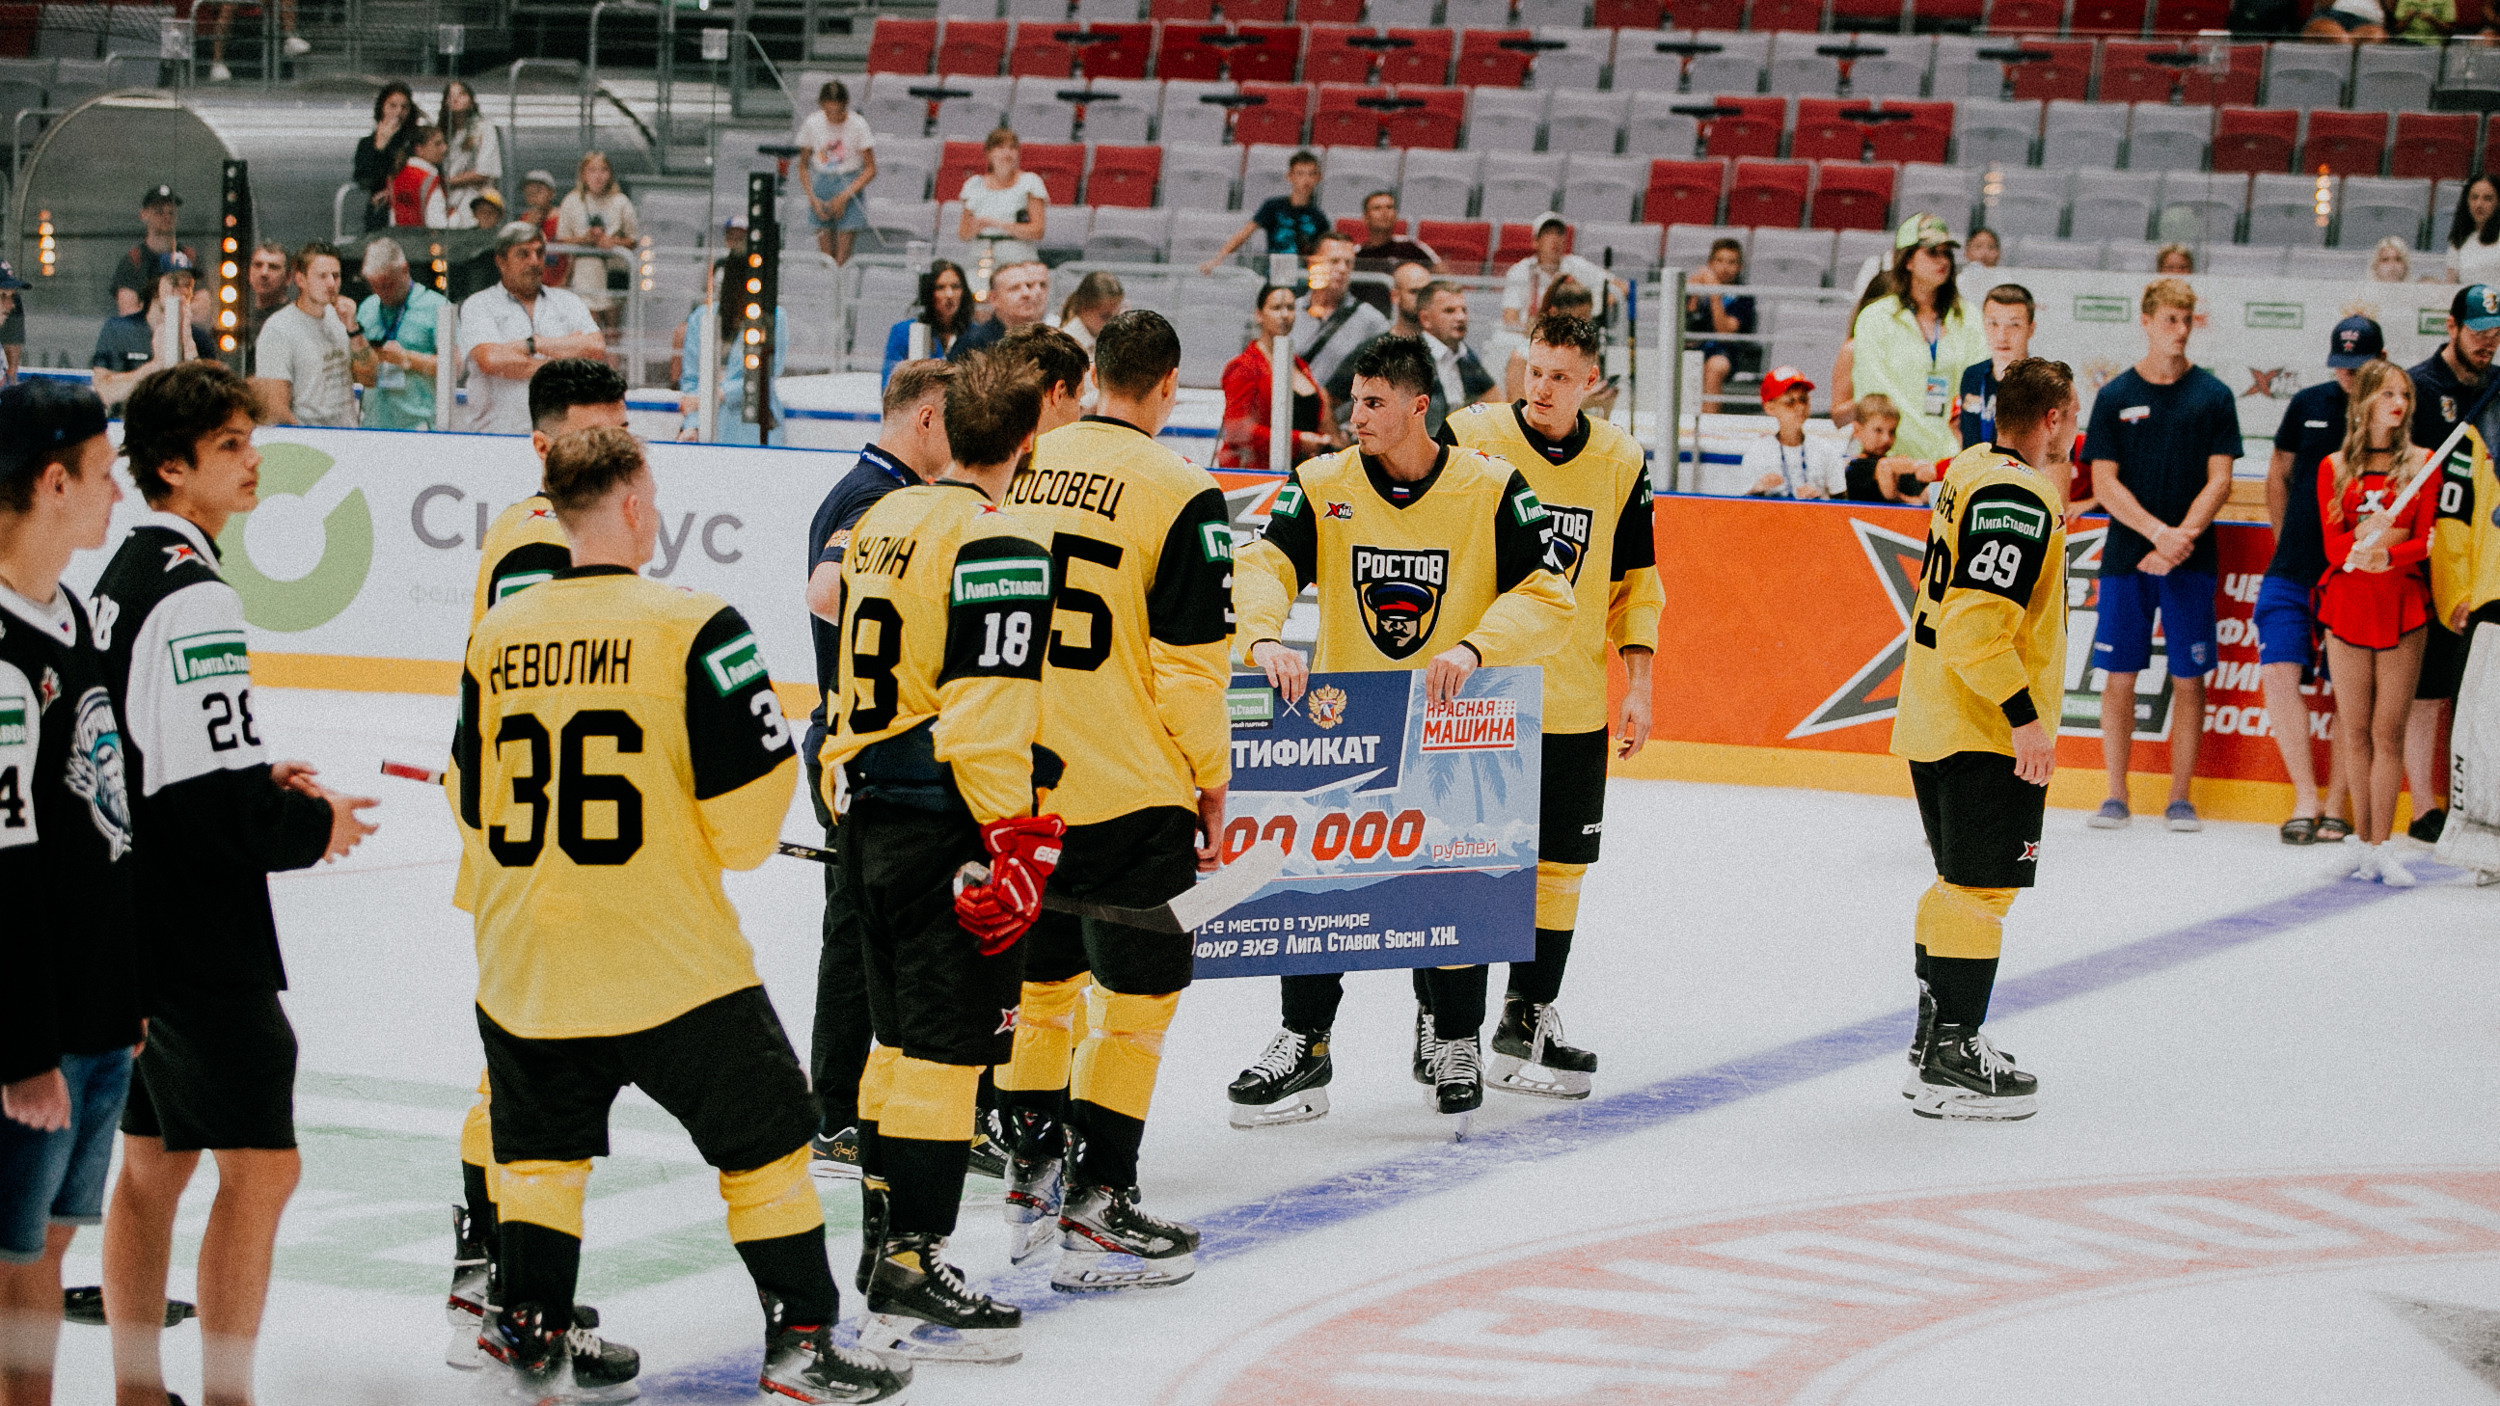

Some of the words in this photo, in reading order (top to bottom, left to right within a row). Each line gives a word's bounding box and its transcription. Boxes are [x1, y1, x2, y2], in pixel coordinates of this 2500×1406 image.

[1357, 551, 1444, 585] РОСТОВ
[1968, 540, 2022, 588] 89
[978, 610, 1032, 667] 18
[1231, 735, 1381, 768] ТИФИКАТ
[1423, 718, 1515, 744] МАШИНА
[489, 709, 643, 867] 36
[1311, 809, 1426, 862] 000
[1433, 838, 1497, 860] рублей
[1228, 917, 1280, 933] место
[1284, 917, 1294, 931] в
[1298, 913, 1370, 932] турнире
